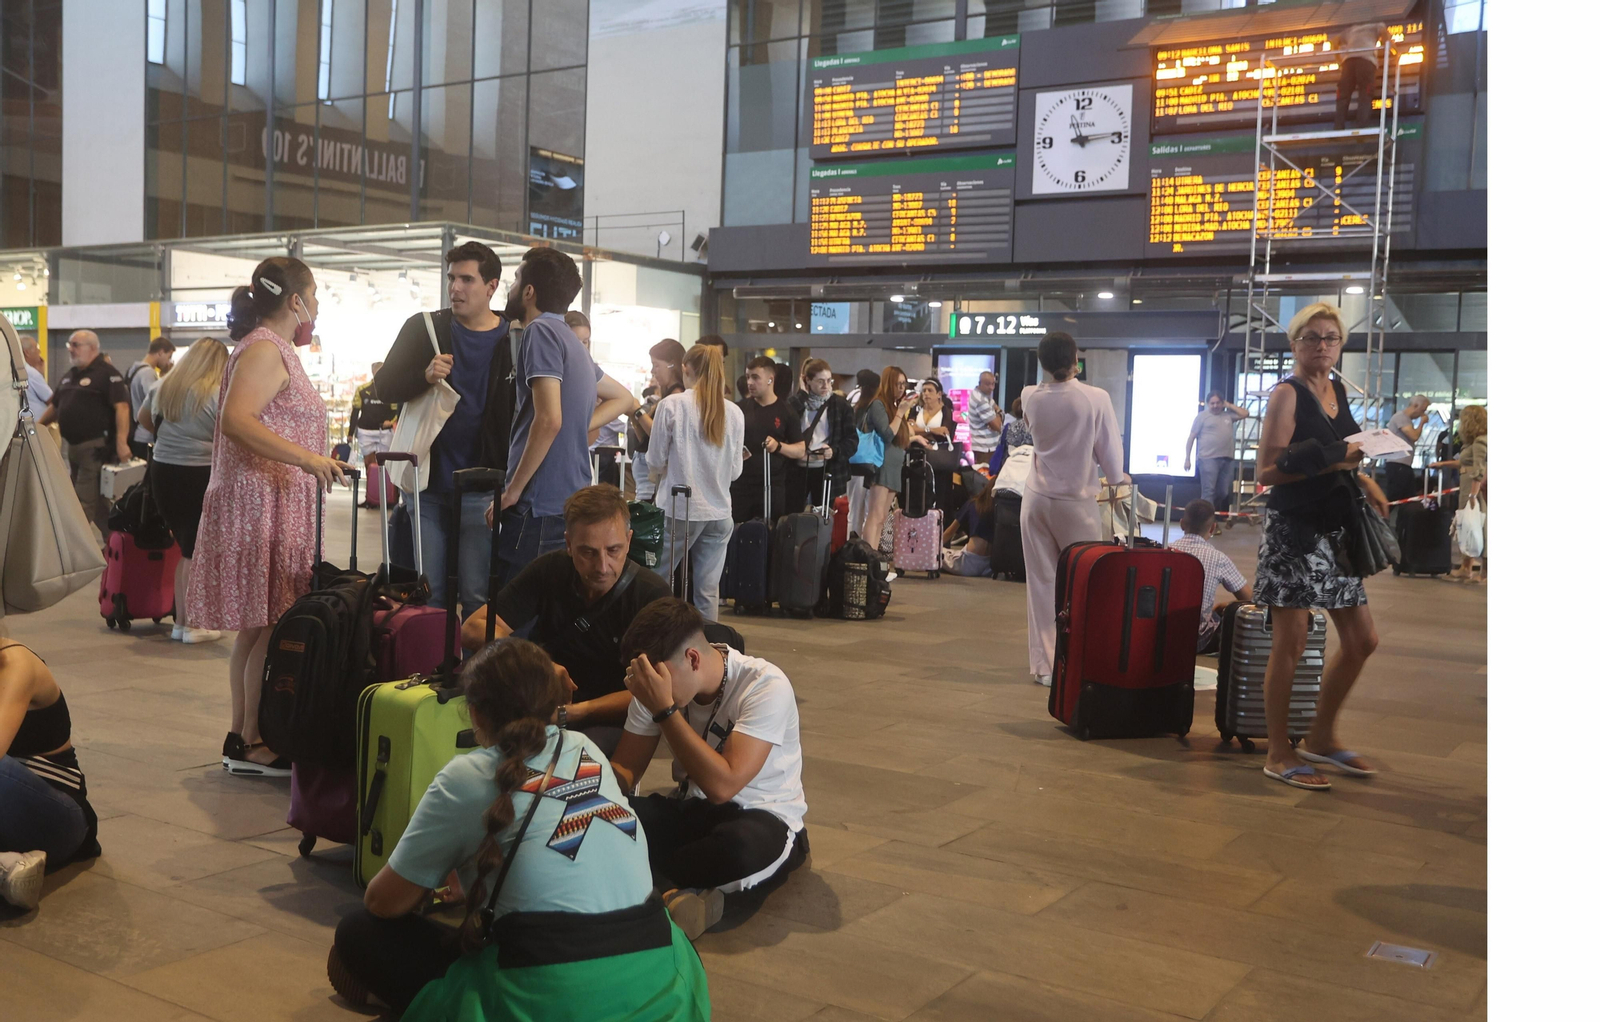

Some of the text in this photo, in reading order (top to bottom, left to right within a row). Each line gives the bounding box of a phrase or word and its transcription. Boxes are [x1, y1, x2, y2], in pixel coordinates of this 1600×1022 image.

[815, 59, 839, 68] Llegadas
[1075, 98, 1093, 111] 12
[1042, 137, 1053, 149] 9
[1111, 132, 1123, 144] 3
[1152, 146, 1177, 155] Salidas
[812, 170, 838, 178] Llegadas
[1075, 171, 1086, 183] 6
[1152, 177, 1175, 188] 11:14
[1213, 202, 1230, 212] RIO
